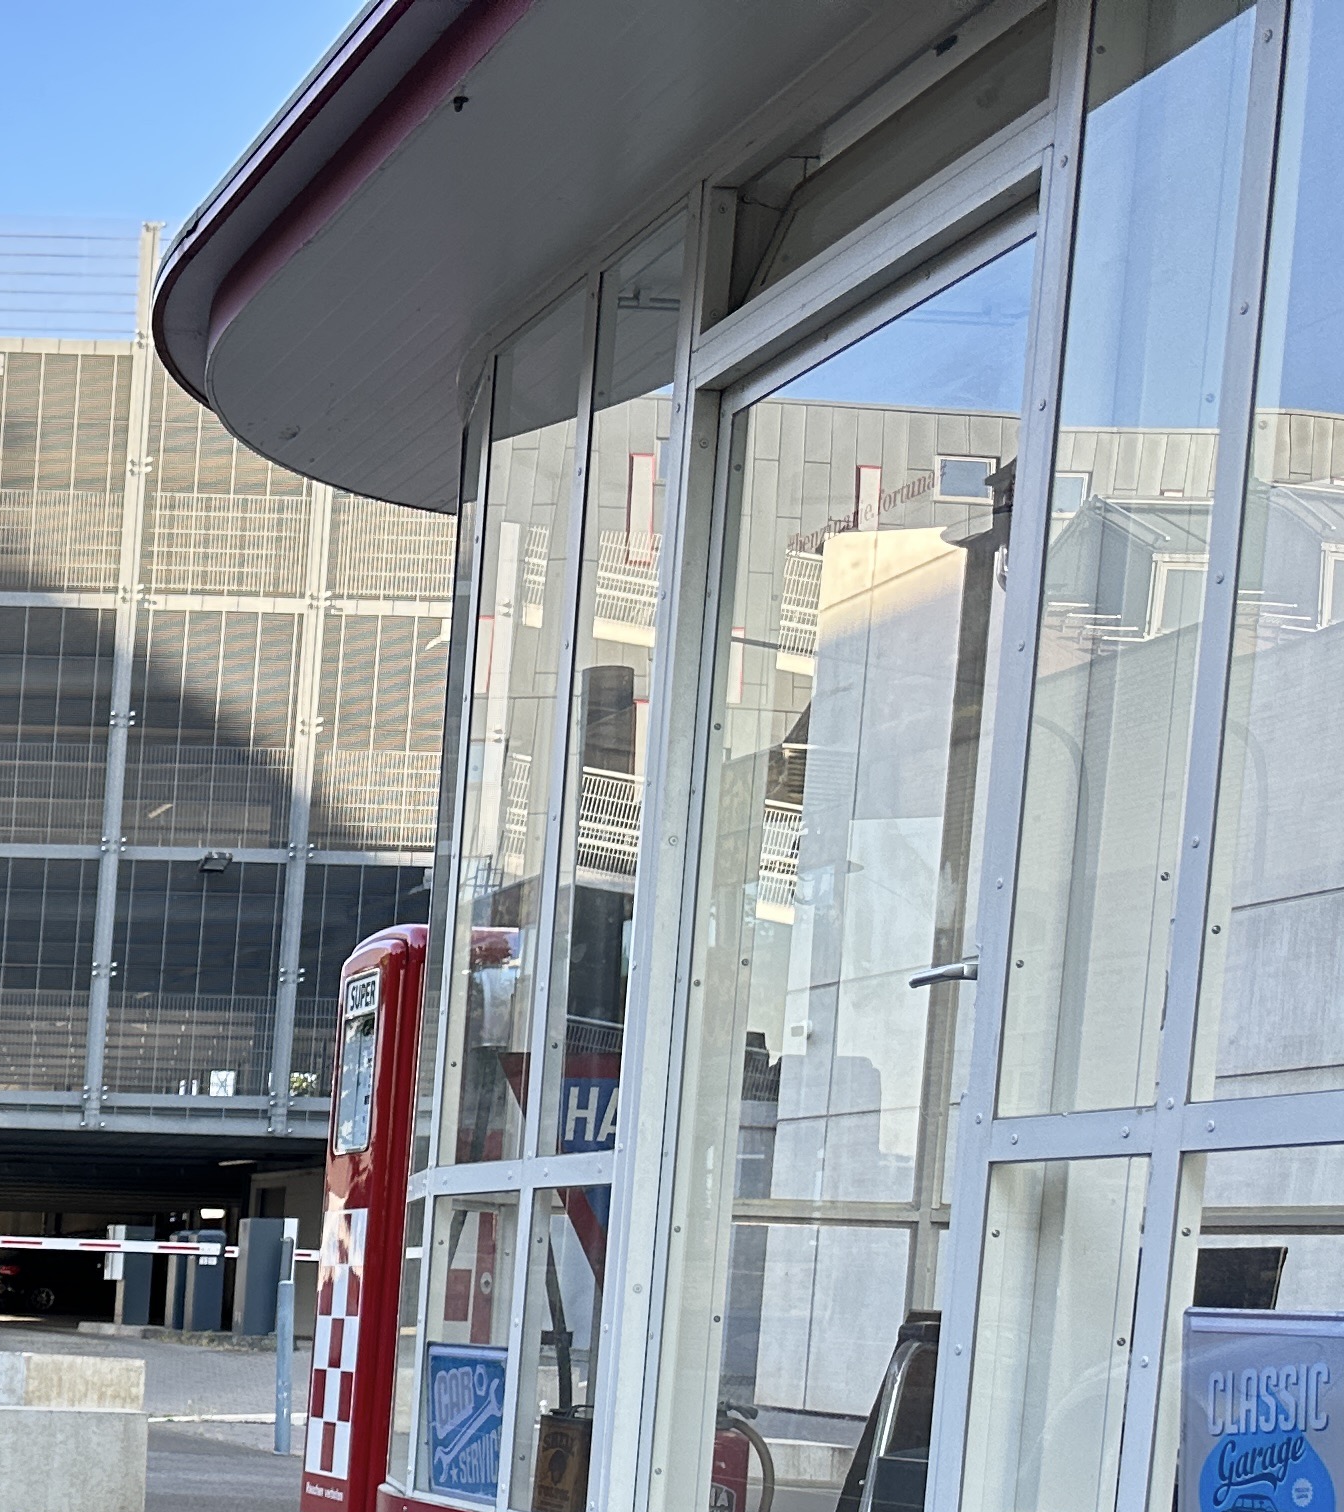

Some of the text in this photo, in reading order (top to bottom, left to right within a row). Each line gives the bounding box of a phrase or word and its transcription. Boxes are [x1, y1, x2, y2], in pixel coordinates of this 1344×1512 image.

[349, 979, 376, 1012] SUPER
[435, 1368, 474, 1428] CAR
[1207, 1361, 1331, 1437] CLASSIC
[458, 1427, 500, 1484] SERVIC
[1213, 1436, 1307, 1507] Garage
